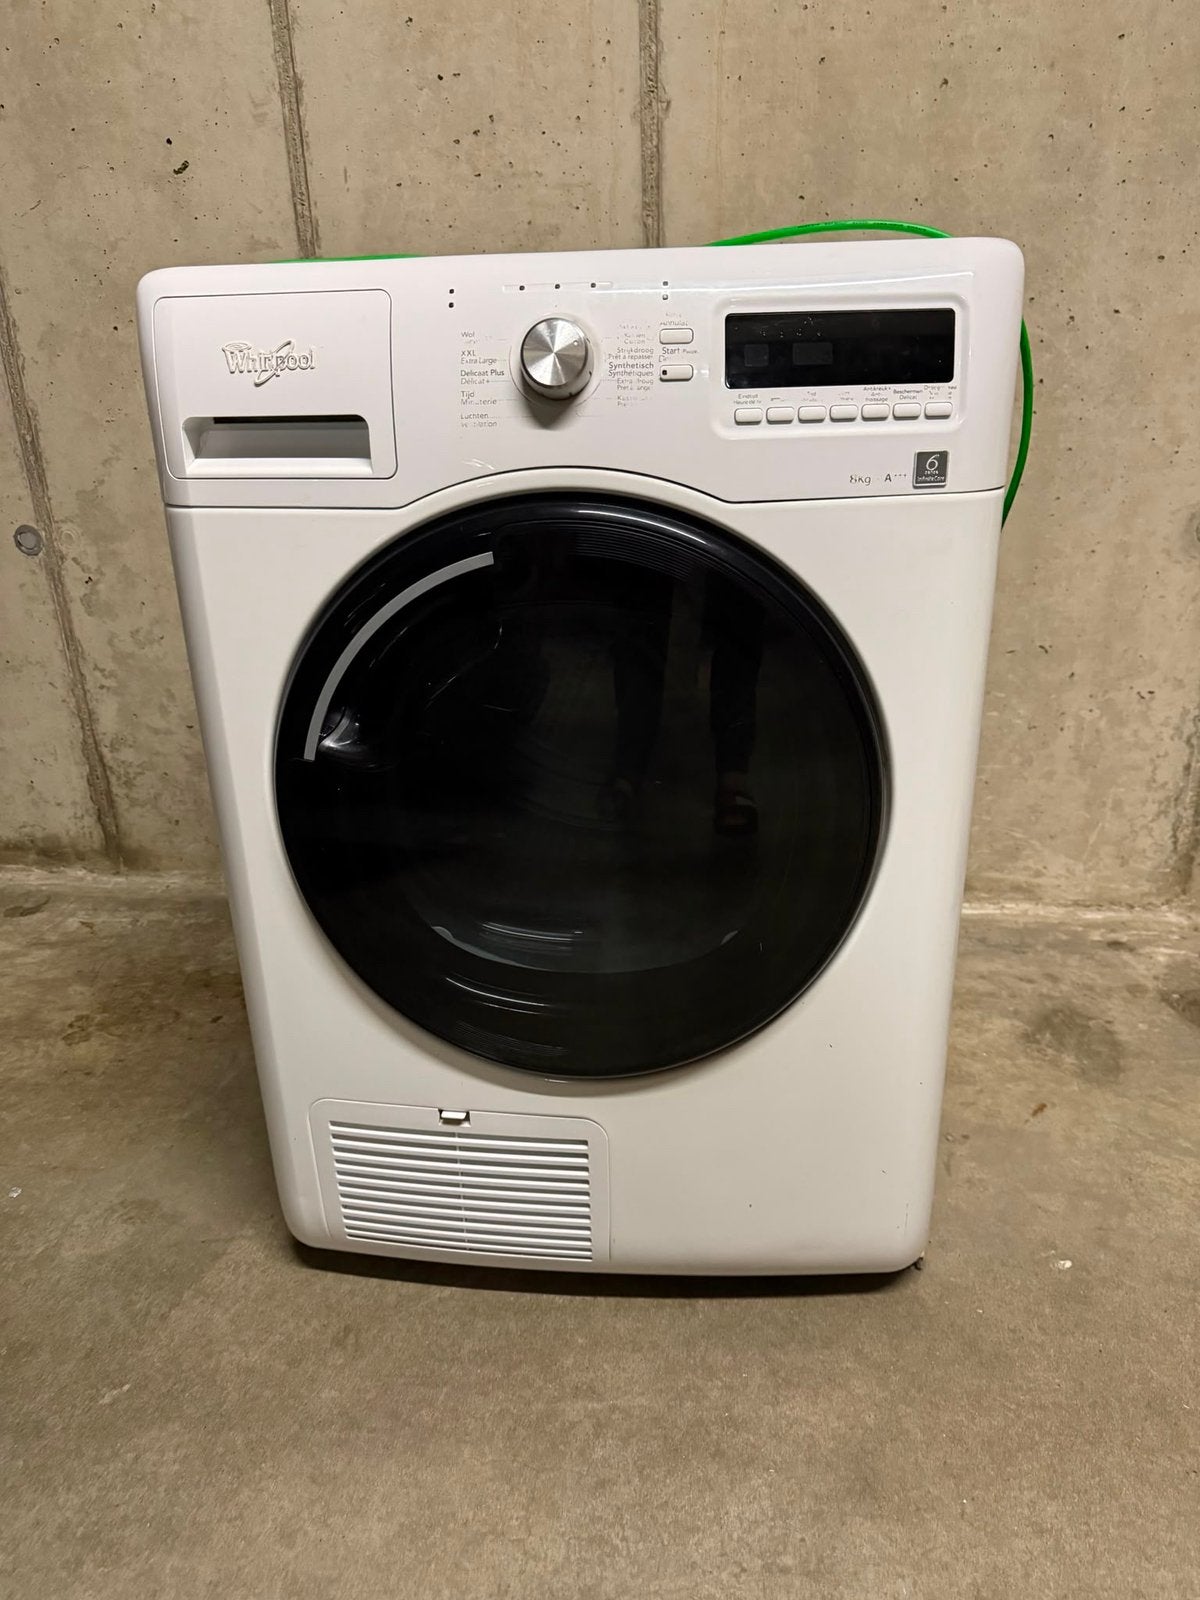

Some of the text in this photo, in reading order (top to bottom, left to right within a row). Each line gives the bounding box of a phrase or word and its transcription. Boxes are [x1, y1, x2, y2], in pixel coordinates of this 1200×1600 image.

[662, 346, 681, 355] Start
[608, 361, 654, 370] Synthetisch
[460, 368, 505, 377] Delicaat Plus
[461, 390, 475, 399] Tijd
[925, 454, 940, 471] 6
